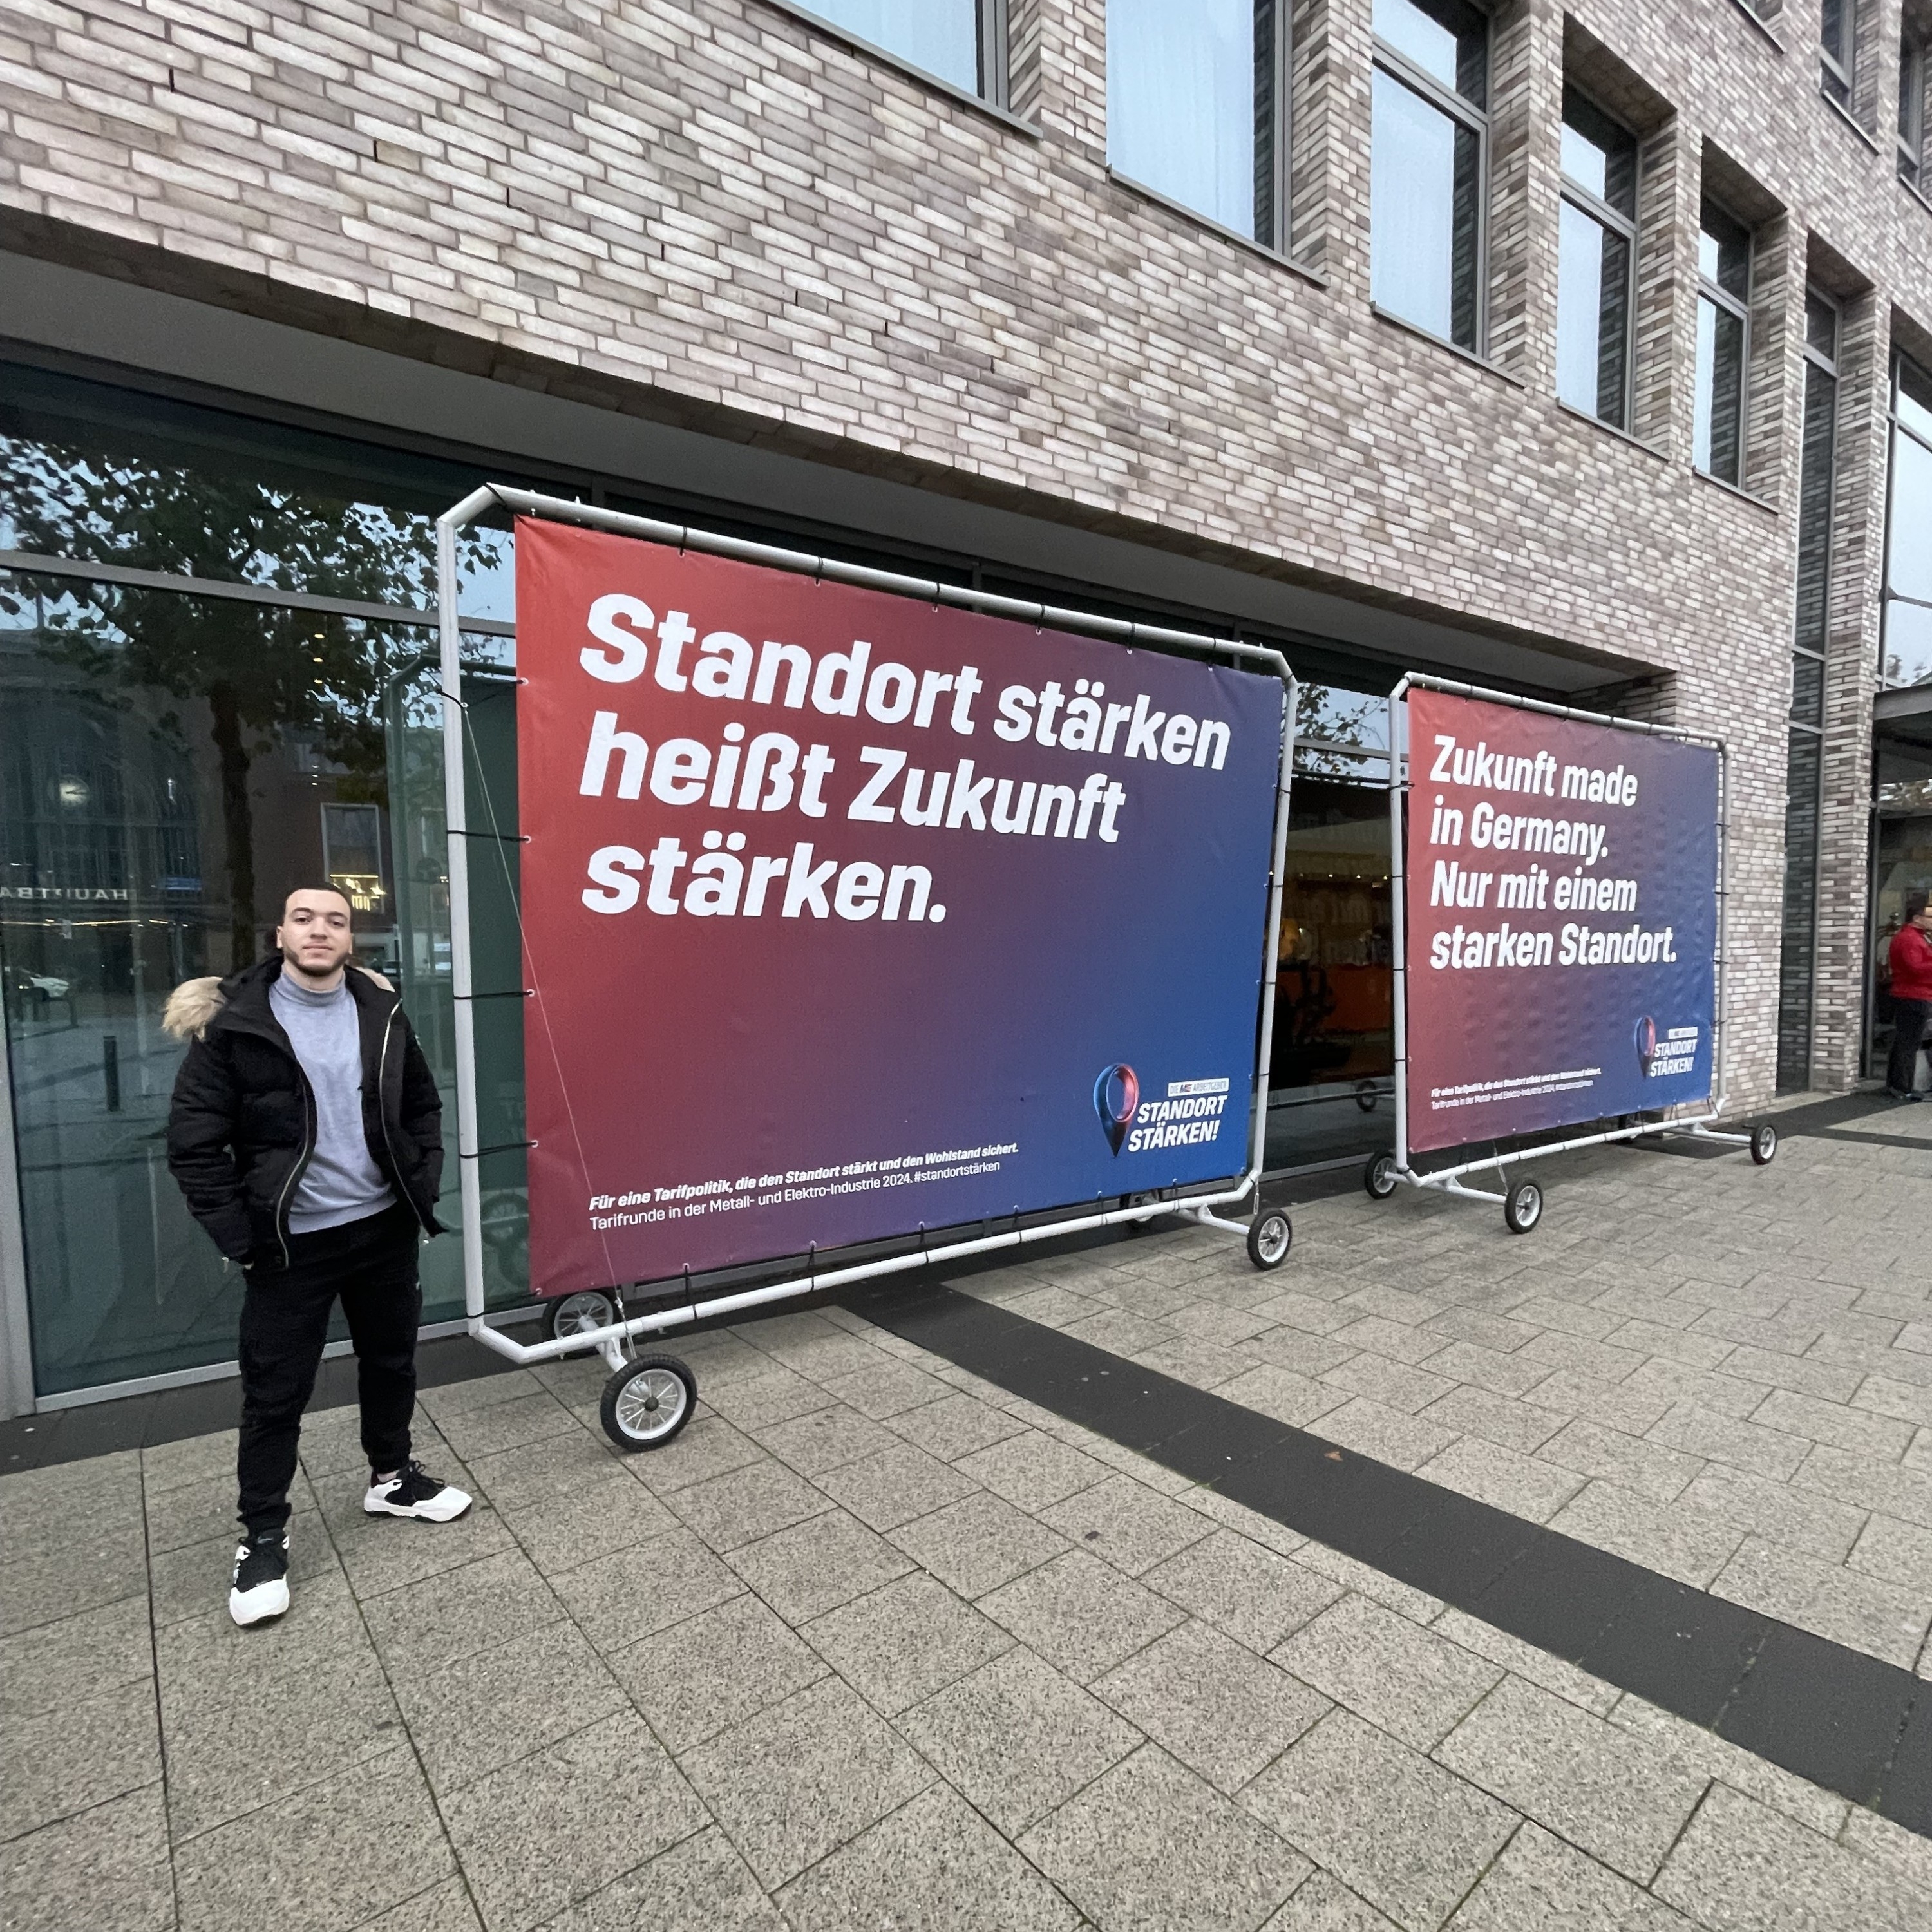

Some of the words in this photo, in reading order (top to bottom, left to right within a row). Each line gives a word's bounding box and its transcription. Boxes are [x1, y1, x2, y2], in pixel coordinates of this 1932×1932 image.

[579, 593, 983, 735] Standort
[993, 678, 1231, 770] stärken
[579, 710, 835, 818] heißt
[847, 746, 1126, 843] Zukunft
[1429, 734, 1558, 797] Zukunft
[1560, 764, 1638, 807] made
[1429, 794, 1464, 846] in
[1470, 802, 1609, 866] Germany.
[581, 830, 947, 923] stärken.
[1430, 860, 1493, 908] Nur
[1497, 863, 1549, 910] mit
[1553, 866, 1638, 911] einem
[1430, 923, 1554, 970] starken
[1558, 922, 1677, 966] Standort.
[1650, 1056, 1694, 1077] STÄRKEN!
[1654, 1039, 1698, 1057] STANDORT
[1128, 1120, 1220, 1152] STÄRKEN!
[1137, 1095, 1227, 1124] STANDORT
[589, 1196, 615, 1211] Für
[617, 1191, 651, 1207] eine
[654, 1179, 734, 1202] Tarifpolitik,
[735, 1176, 756, 1191] die
[759, 1173, 783, 1188] den
[785, 1165, 841, 1184] Standort
[842, 1160, 878, 1175] stärkt
[879, 1157, 902, 1171] und
[902, 1155, 923, 1168] den
[925, 1147, 981, 1165] Wohlstand
[981, 1142, 1019, 1157] sichert.
[589, 1208, 665, 1231] Tarifrunde
[668, 1206, 681, 1219] in
[684, 1202, 707, 1217] der
[710, 1195, 755, 1213] Metall-
[758, 1191, 781, 1206] und
[784, 1177, 880, 1202] Elektro-Industrie
[882, 1173, 913, 1188] 2024.
[914, 1160, 1000, 1183] #standortstärken
